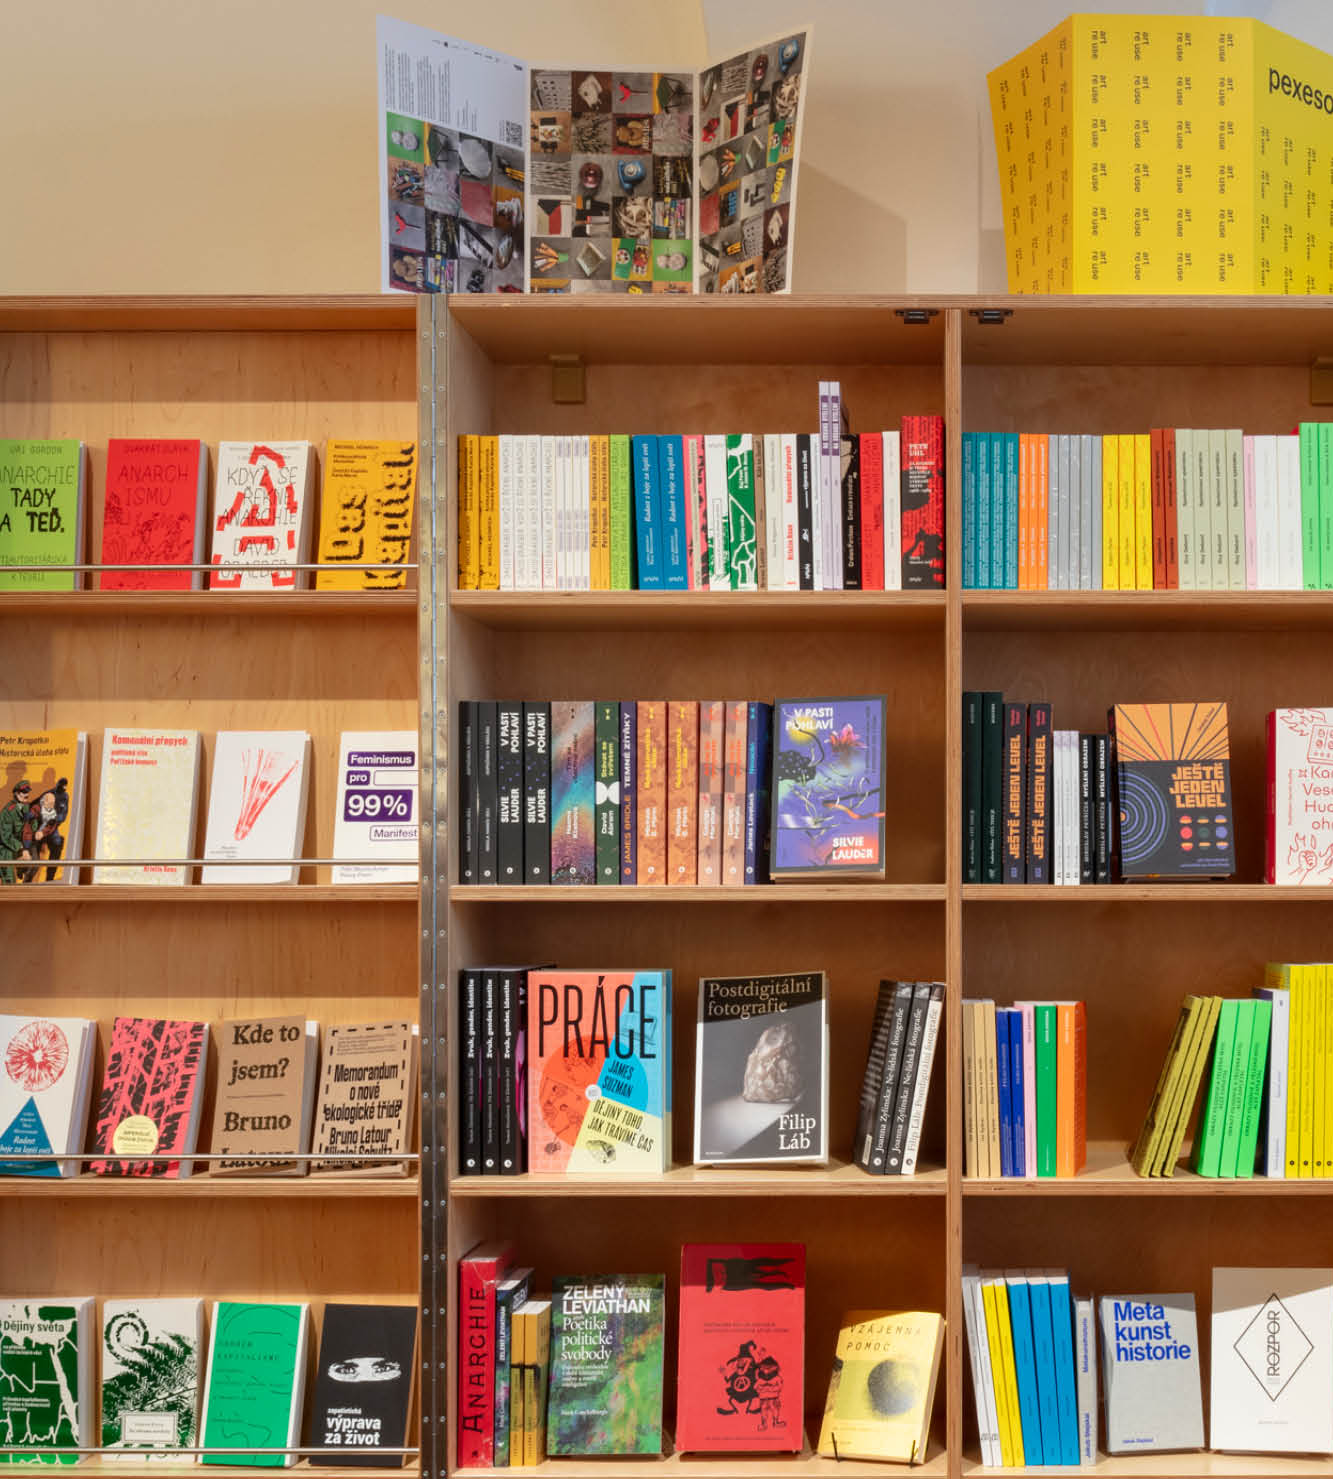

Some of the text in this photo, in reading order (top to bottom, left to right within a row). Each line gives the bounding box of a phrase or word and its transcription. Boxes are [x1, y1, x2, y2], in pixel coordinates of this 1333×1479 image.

[10, 487, 56, 508] TADY
[0, 513, 12, 533] A
[805, 707, 834, 718] PASTI
[501, 712, 509, 738] PASTI
[511, 712, 519, 754] POHLAVÍ
[527, 712, 536, 738] PASTI
[537, 712, 546, 754] POHLAVÍ
[350, 753, 413, 767] Feminismus
[349, 773, 369, 786] pro
[1171, 762, 1225, 780] JEŠTĚ
[622, 712, 632, 864] JAMES BRIDLE TEMNÉ ZÍTŘKY
[1008, 734, 1022, 860] JEŠTĚ JEDEN LEVEL
[1032, 734, 1047, 860] JEŠTĚ JEDEN LEVEL
[1169, 779, 1225, 794] JEDEN
[347, 793, 409, 818] 99%
[501, 796, 509, 824] SILVIE
[511, 788, 520, 824] LAUDER
[527, 796, 536, 824] SILVIE
[537, 788, 547, 824] LAUDER
[373, 828, 418, 840] Manifest
[832, 836, 865, 848] SILVIE
[832, 848, 874, 860] LAUDER
[708, 978, 812, 1000] Postdigitální
[538, 975, 657, 1059] PRÁCE
[707, 997, 789, 1020] fotografie
[231, 1024, 301, 1046] Kde to
[227, 1057, 291, 1087] jsem?
[333, 1061, 399, 1083] Memorandum
[607, 1060, 635, 1081] JAMES
[349, 1081, 381, 1101] o nové
[602, 1075, 634, 1099] SUZMAN
[592, 1099, 621, 1122] DĚJINY
[223, 1111, 292, 1133] Bruno
[778, 1113, 817, 1131] Filip
[329, 1126, 392, 1146] Bruno Latour
[586, 1116, 655, 1153] JAK TRÁVÍME ČAS
[778, 1132, 811, 1150] Láb
[562, 1282, 624, 1301] ZELENÝ
[562, 1299, 651, 1315] LEVIATHAN
[1113, 1301, 1165, 1322] Meta
[3, 1320, 66, 1334] Dějiny světa
[562, 1317, 607, 1331] Poetika
[1115, 1321, 1172, 1341] kunst
[562, 1331, 613, 1349] politické
[846, 1341, 892, 1352] POMOC
[1266, 1309, 1281, 1377] ROZPOR
[462, 1287, 489, 1434] ANARCHIE
[560, 1346, 613, 1361] svobody
[1116, 1340, 1192, 1362] historie
[326, 1416, 382, 1434] výprava
[324, 1429, 381, 1446] za život
